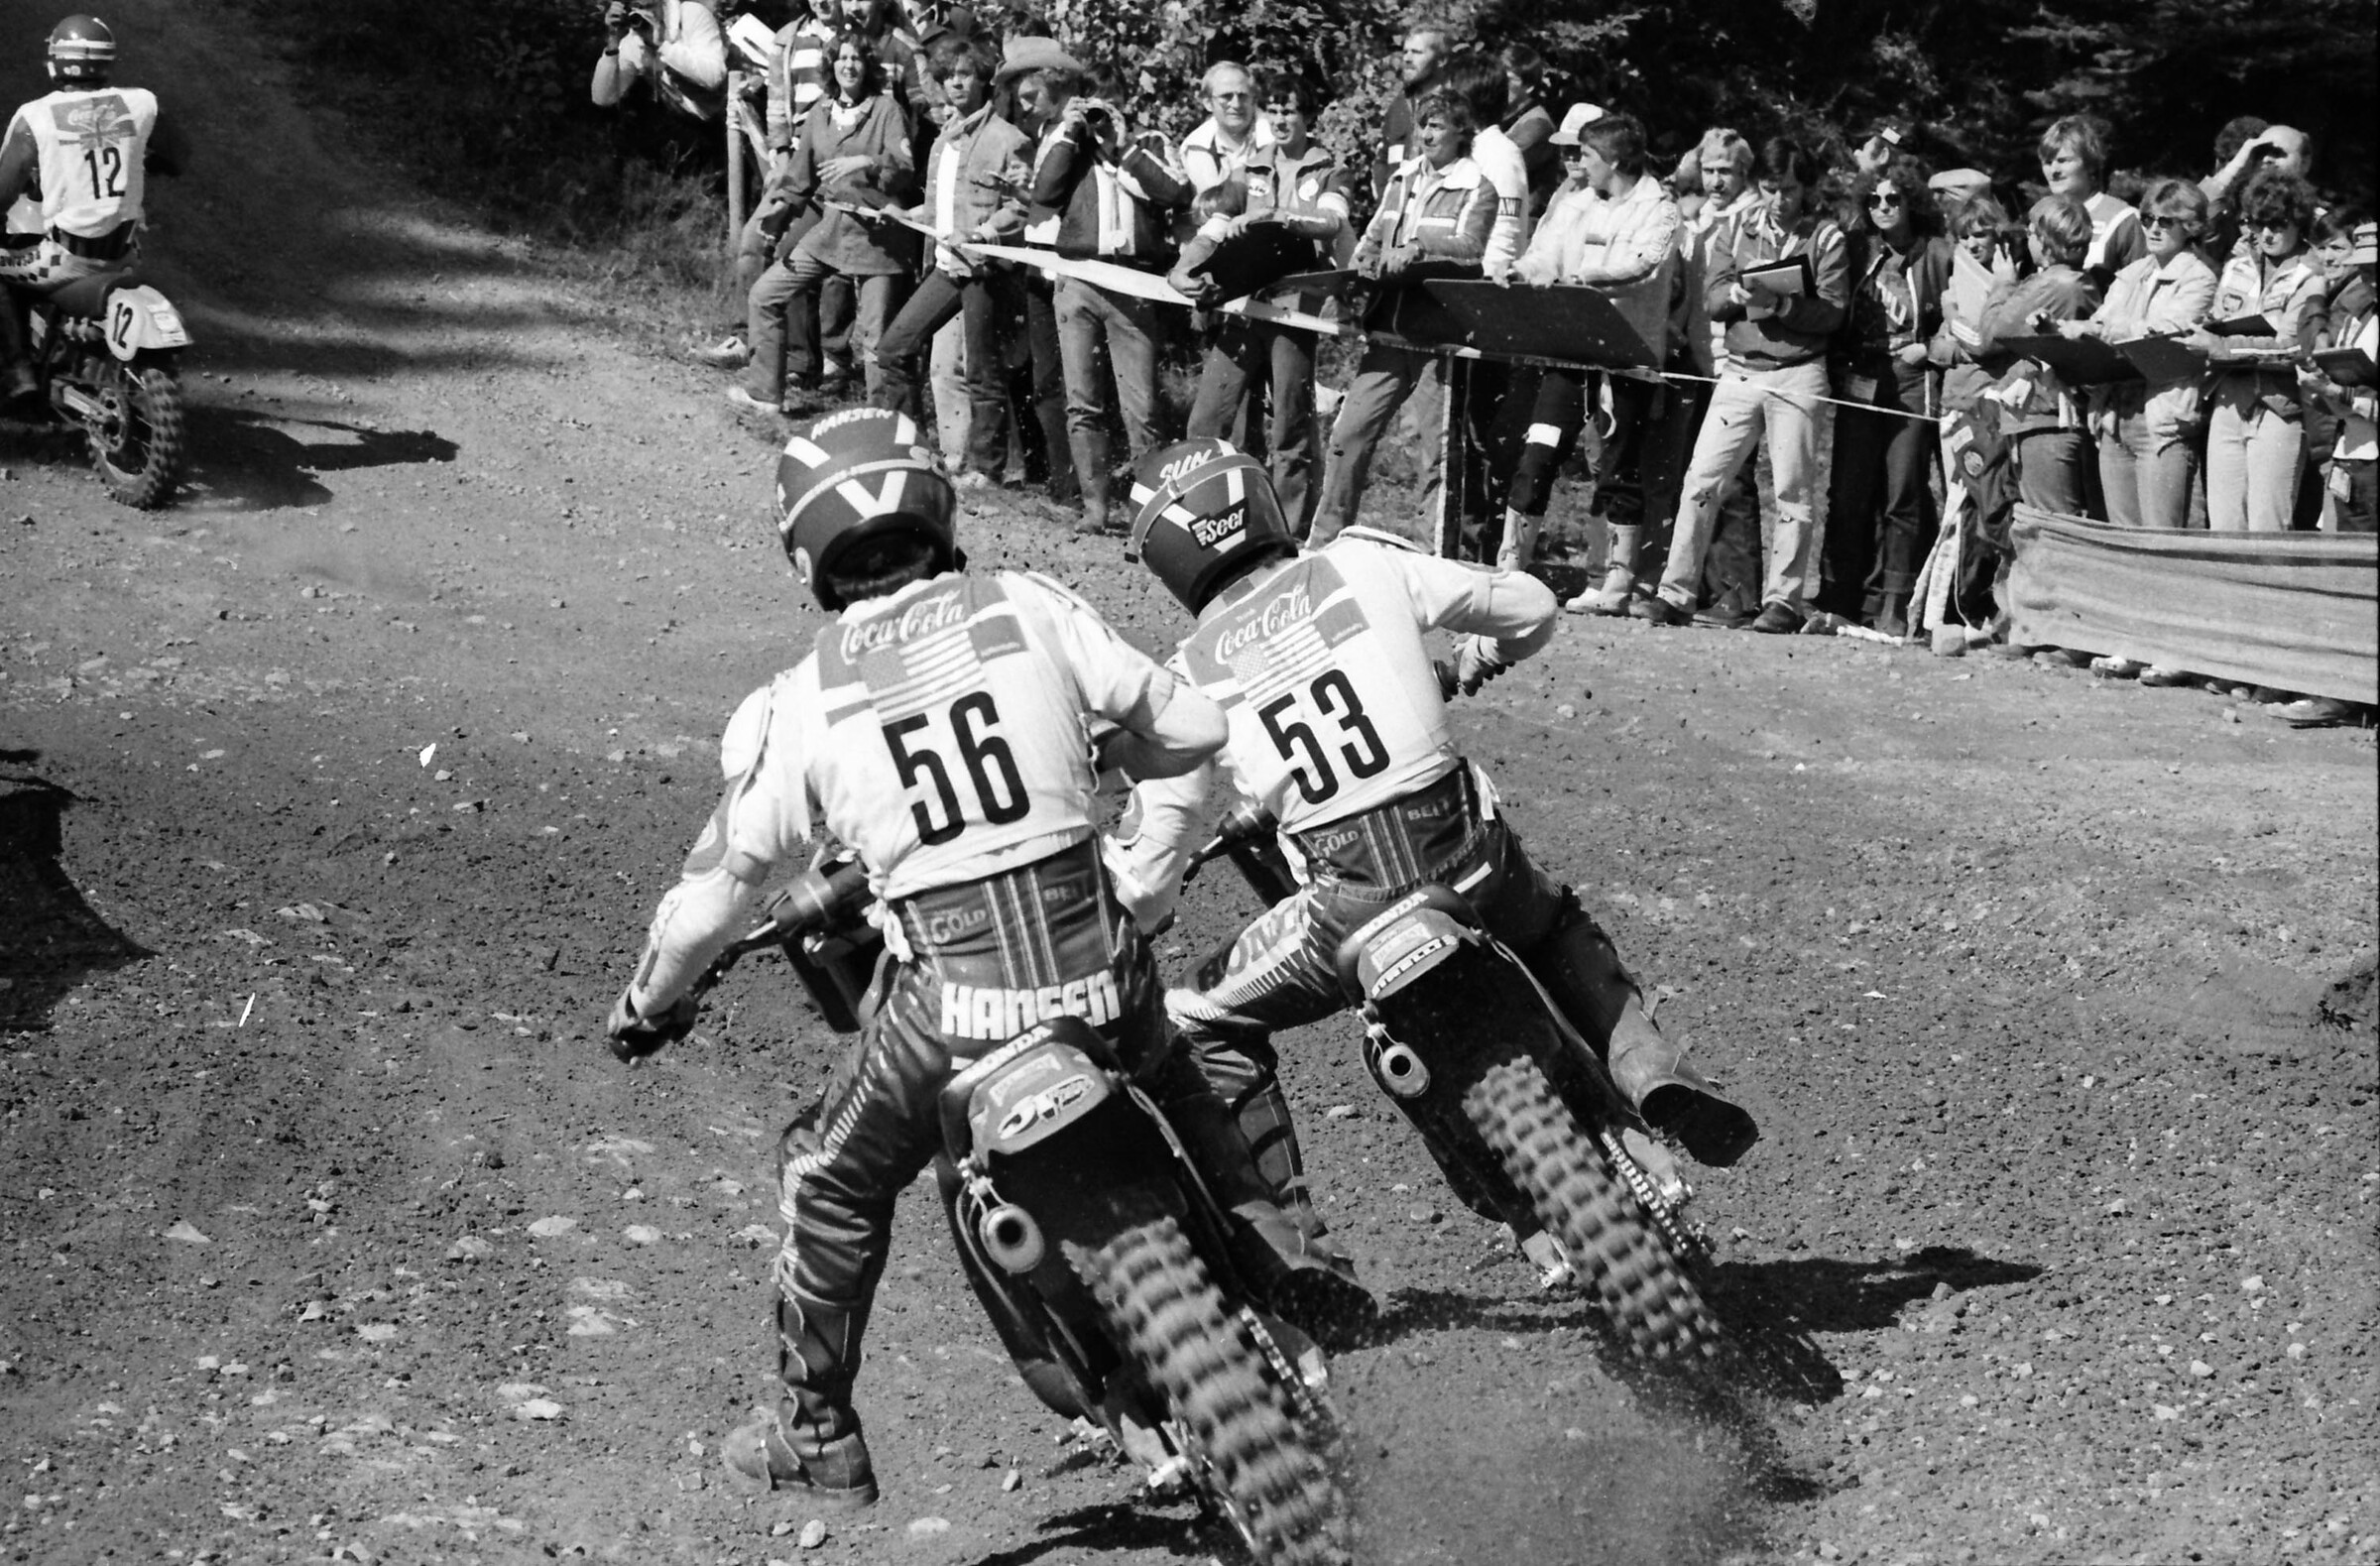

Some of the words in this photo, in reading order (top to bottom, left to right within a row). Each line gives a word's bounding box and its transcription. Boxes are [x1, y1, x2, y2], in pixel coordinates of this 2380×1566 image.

[85, 147, 126, 199] 12
[112, 301, 134, 349] 12
[810, 407, 893, 440] HANSEN
[1158, 448, 1213, 480] SUN
[1205, 508, 1246, 543] Seer
[840, 589, 965, 665] Coca-Cola
[1215, 583, 1311, 665] Coca-Cola
[1257, 668, 1390, 804] 53
[881, 690, 1030, 845] 56
[930, 907, 987, 943] GOLD
[1352, 892, 1429, 943] HONDA
[941, 969, 1121, 1040] HANSEN
[958, 1025, 1053, 1085] HONDA
